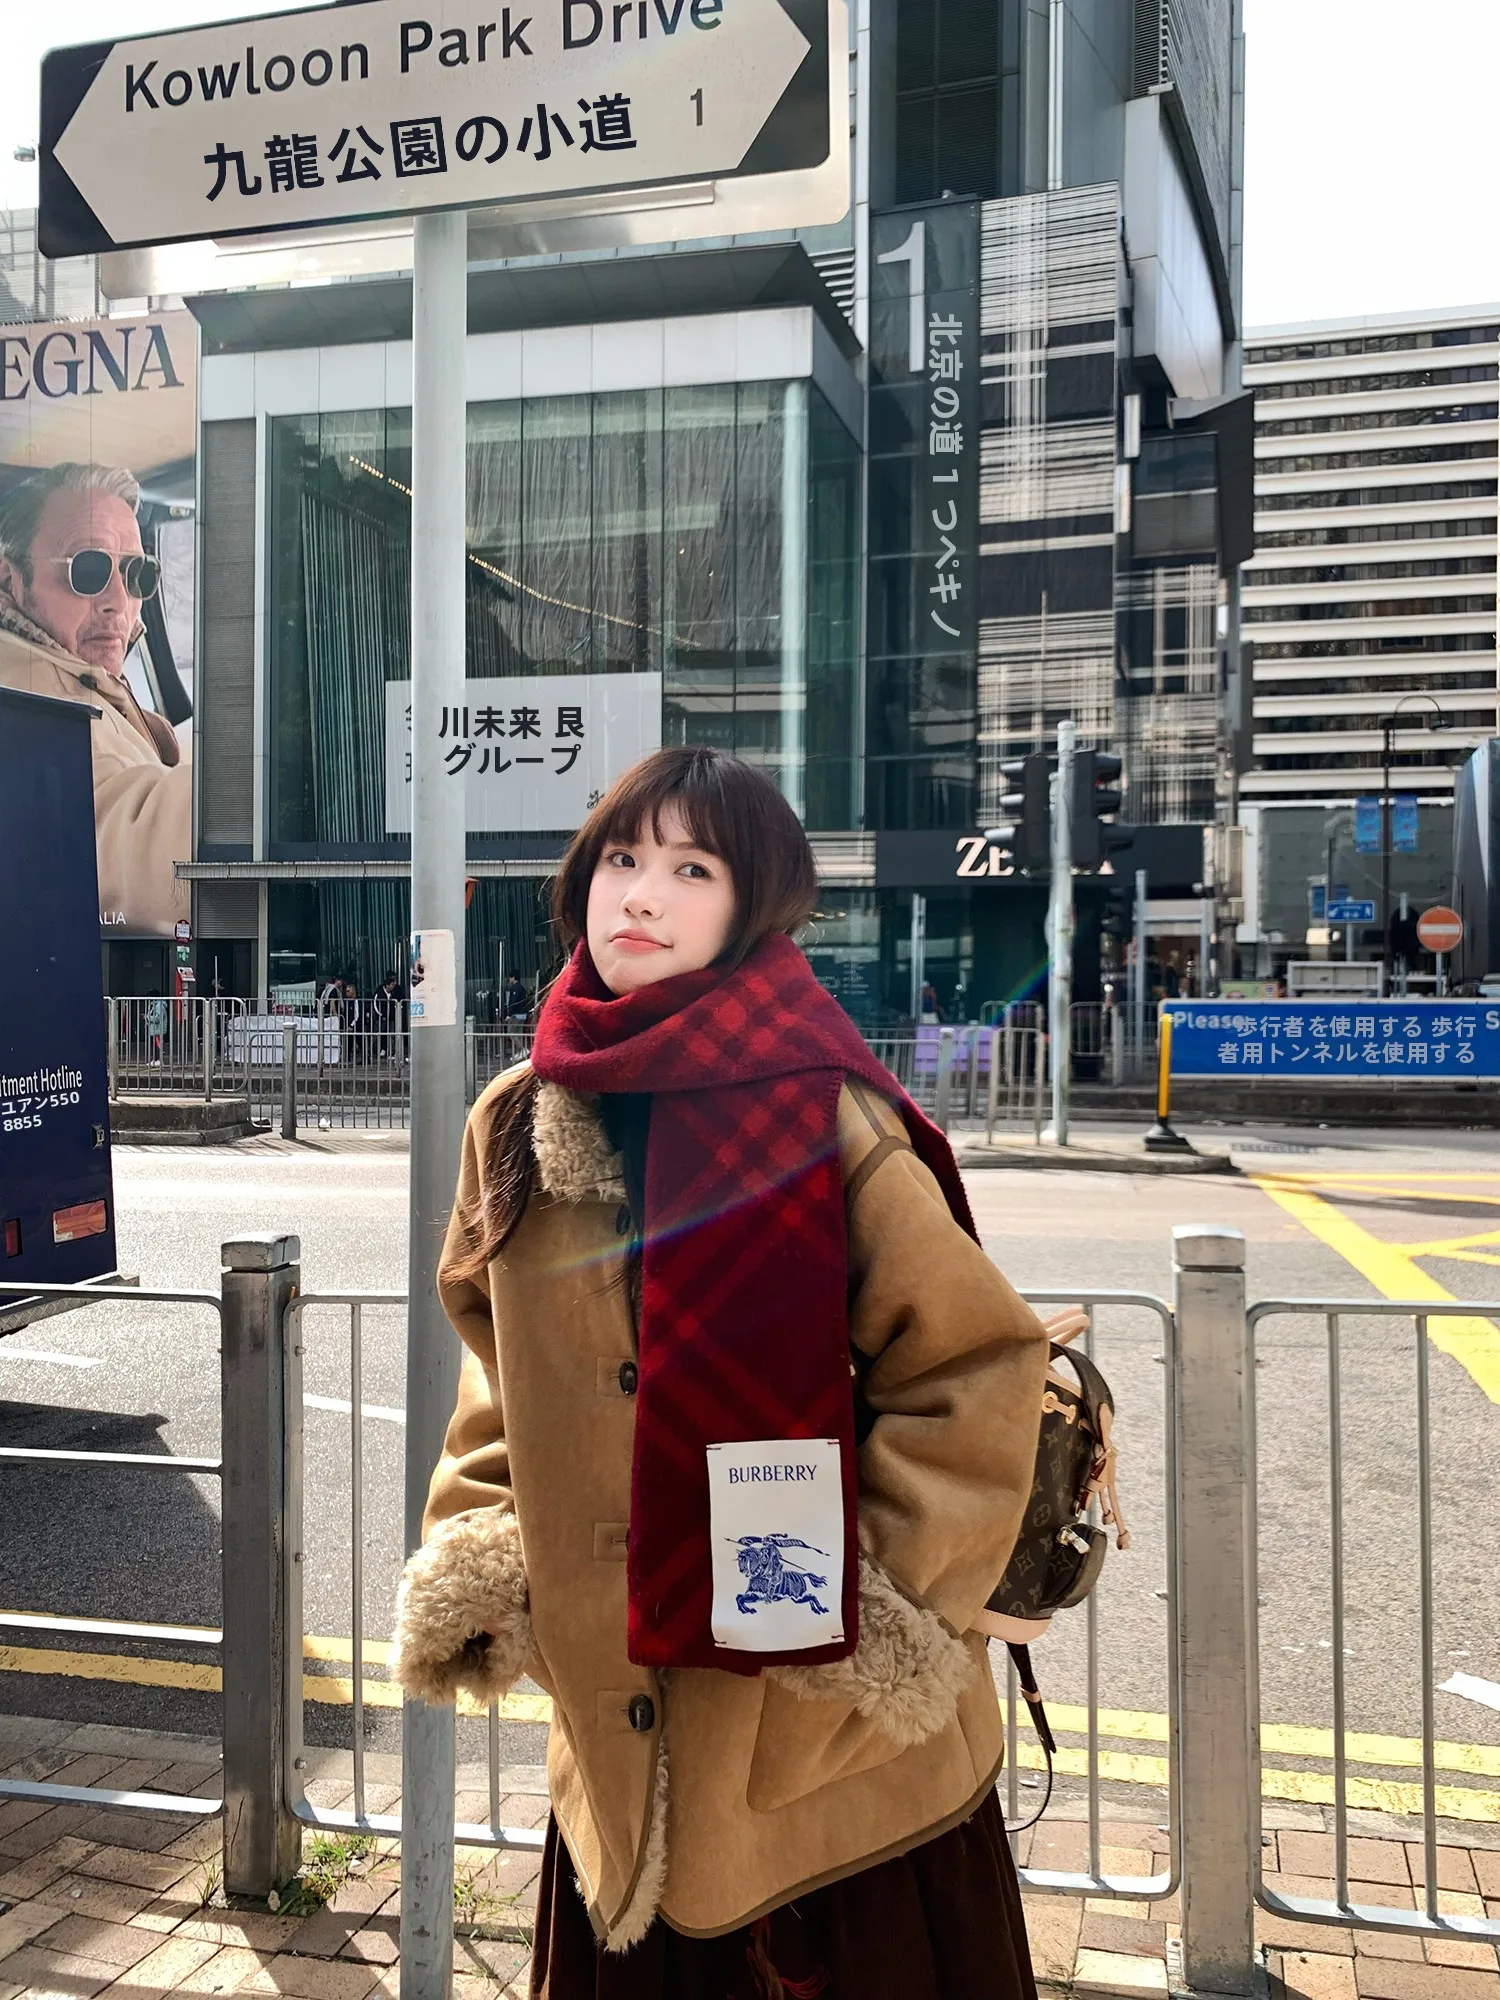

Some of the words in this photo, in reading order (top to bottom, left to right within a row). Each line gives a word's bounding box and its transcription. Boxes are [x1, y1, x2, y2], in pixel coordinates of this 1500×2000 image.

[126, 44, 370, 112] Kowloon
[399, 9, 533, 73] Park
[565, 0, 724, 50] Drive
[203, 92, 637, 202] 九龍公園の小道
[690, 88, 705, 127] 1
[877, 221, 926, 372] 1
[0, 324, 185, 400] EGNA
[443, 742, 582, 776] グループ
[1173, 1010, 1244, 1029] Please
[1217, 1042, 1475, 1065] 者用トンネルを使用する
[40, 1065, 83, 1092] Hotline
[3, 1114, 43, 1132] 8855
[728, 1465, 818, 1484] BURBERRY
